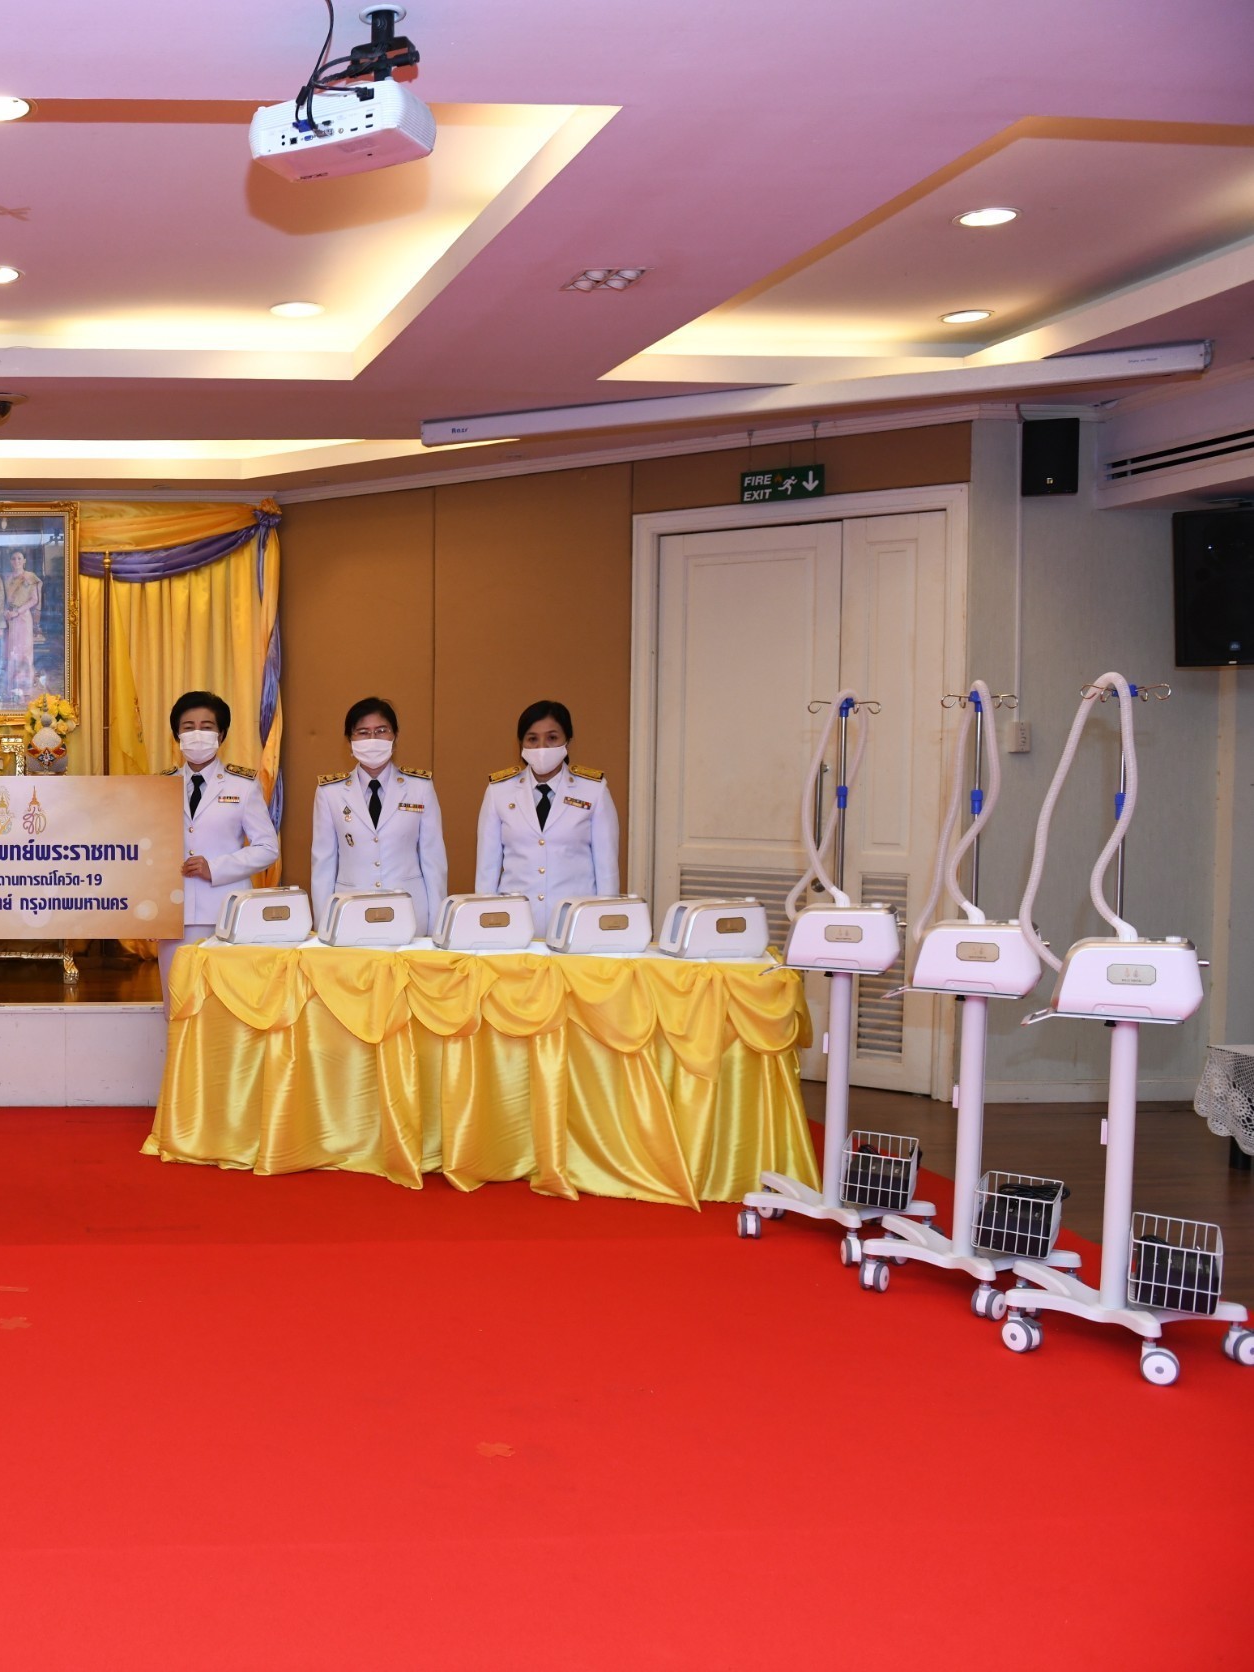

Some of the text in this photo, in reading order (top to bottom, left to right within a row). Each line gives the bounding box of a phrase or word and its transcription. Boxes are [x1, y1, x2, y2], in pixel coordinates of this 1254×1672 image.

[744, 474, 772, 487] FIRE
[743, 489, 772, 502] EXIT
[20, 896, 129, 915] กรุงเทพมหานคร
